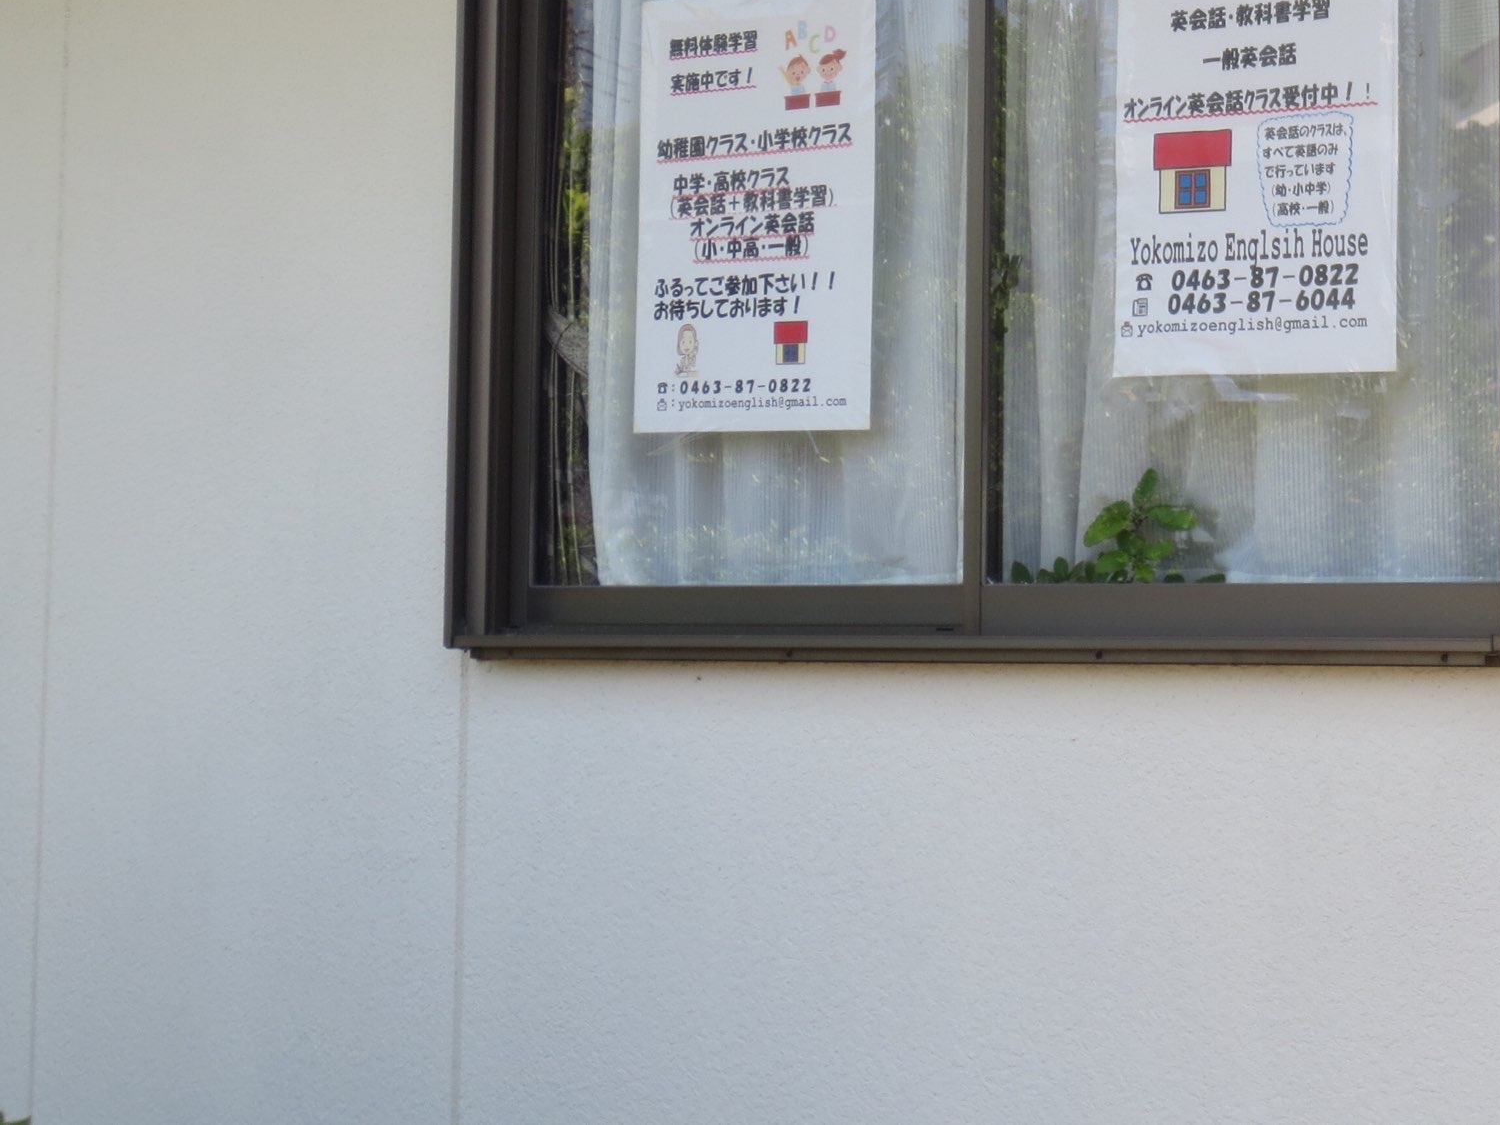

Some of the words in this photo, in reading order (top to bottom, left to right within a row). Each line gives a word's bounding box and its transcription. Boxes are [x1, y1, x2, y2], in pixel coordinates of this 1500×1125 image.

[669, 30, 758, 58] 無料体験学習
[1203, 43, 1297, 71] 一般英会話
[670, 67, 753, 92] 実施中です！
[657, 123, 851, 159] 幼稚園クラス・小学校クラス
[1262, 143, 1338, 159] すべて英語のみ
[673, 166, 790, 195] 中学・高校クラス
[1265, 162, 1336, 178] で行っています
[690, 211, 815, 237] オンライン英会話
[1131, 233, 1218, 265] Yokomizo
[1225, 228, 1304, 266] Englsih
[1312, 229, 1368, 259] House
[654, 271, 836, 298] ふるってご参加下さい！！
[1171, 263, 1359, 291] 0463-87-0822
[653, 295, 800, 321] お待ちしております！
[1168, 288, 1356, 315] 0463-87-6044
[1137, 316, 1368, 337] yokomizoenglish@gmail.com
